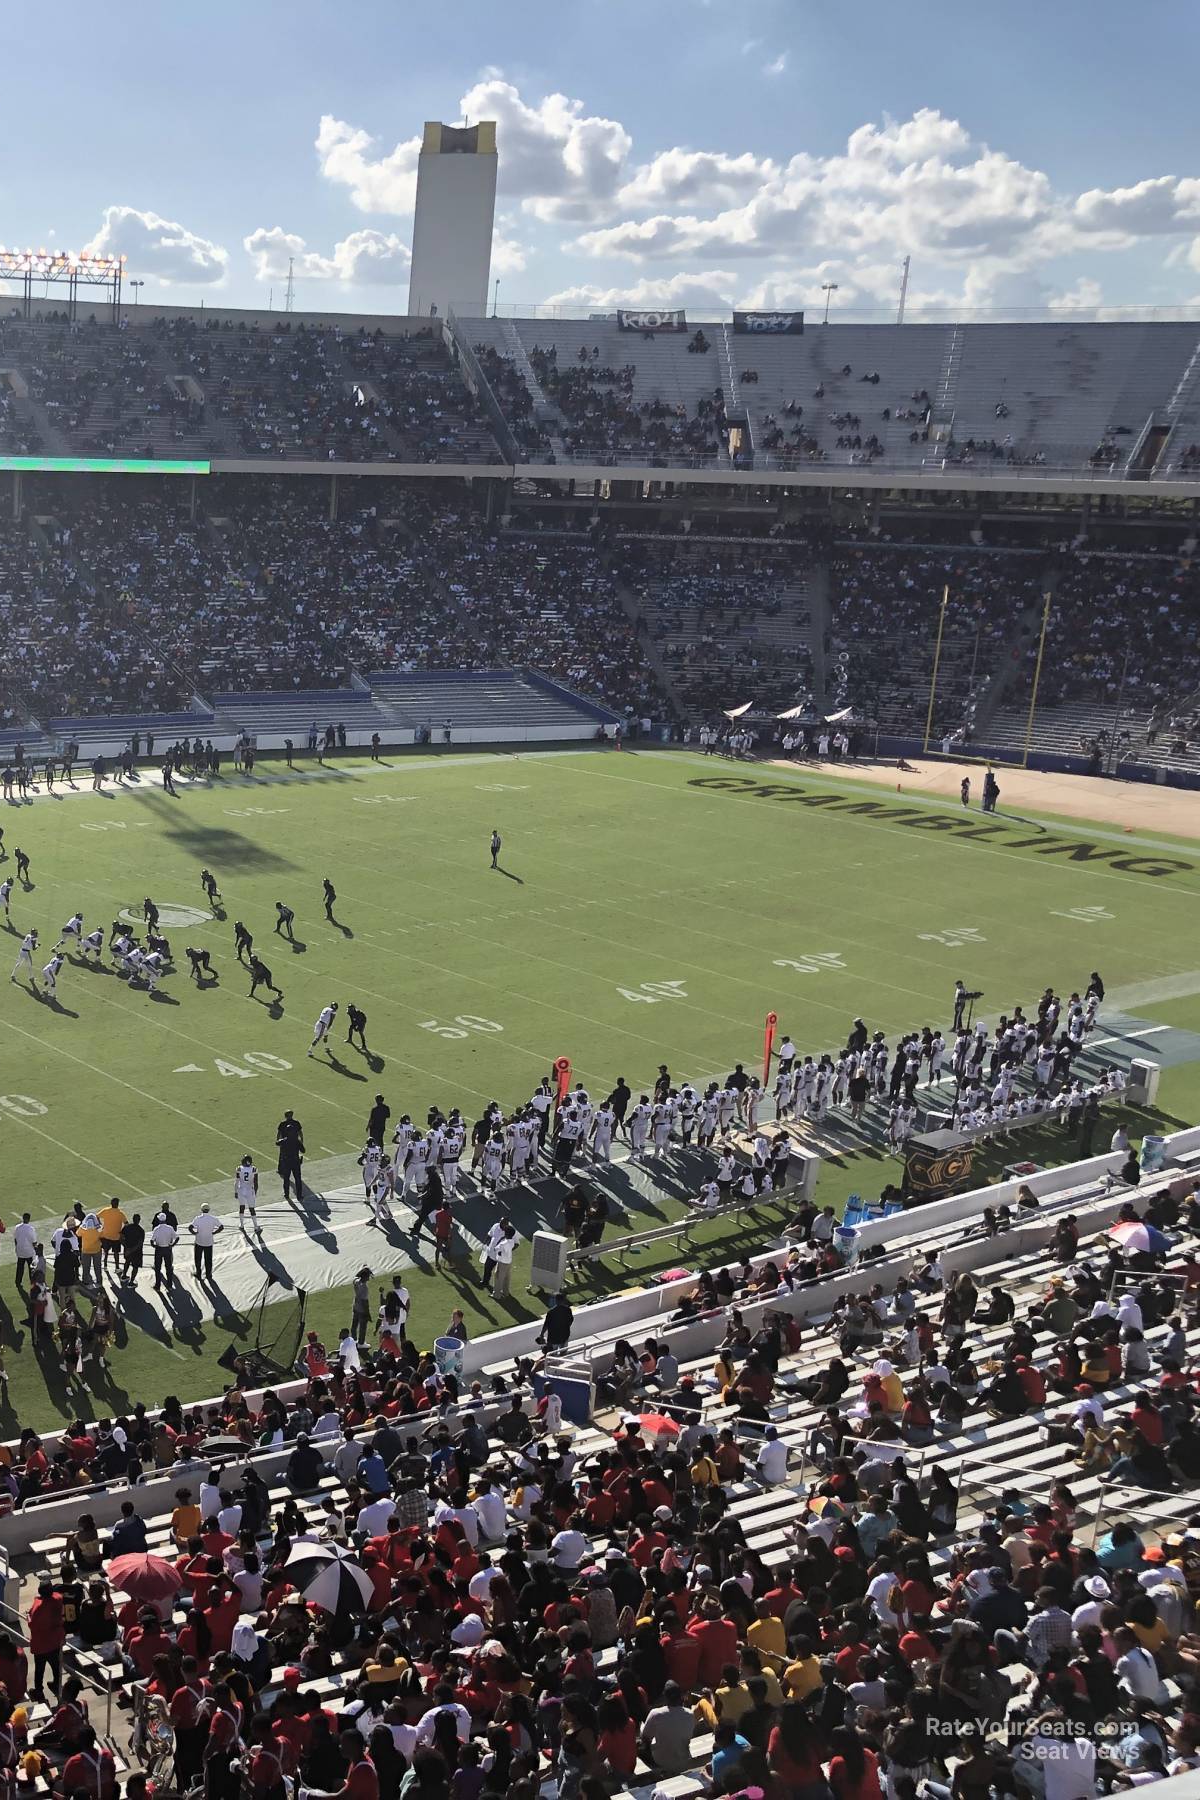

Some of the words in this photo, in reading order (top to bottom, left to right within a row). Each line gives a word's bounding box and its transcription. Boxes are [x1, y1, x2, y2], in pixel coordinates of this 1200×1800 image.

[687, 777, 1195, 877] GRAMBLING
[1049, 906, 1115, 922] 10
[916, 929, 987, 947] 20
[772, 953, 847, 973] 30
[615, 982, 689, 1003] 40
[417, 1015, 504, 1039] 50
[213, 1051, 294, 1079] 40
[569, 1125, 579, 1135] 73
[604, 1117, 609, 1127] 8
[370, 1153, 379, 1162] 26
[449, 1144, 459, 1154] 62
[244, 1171, 250, 1182] 2
